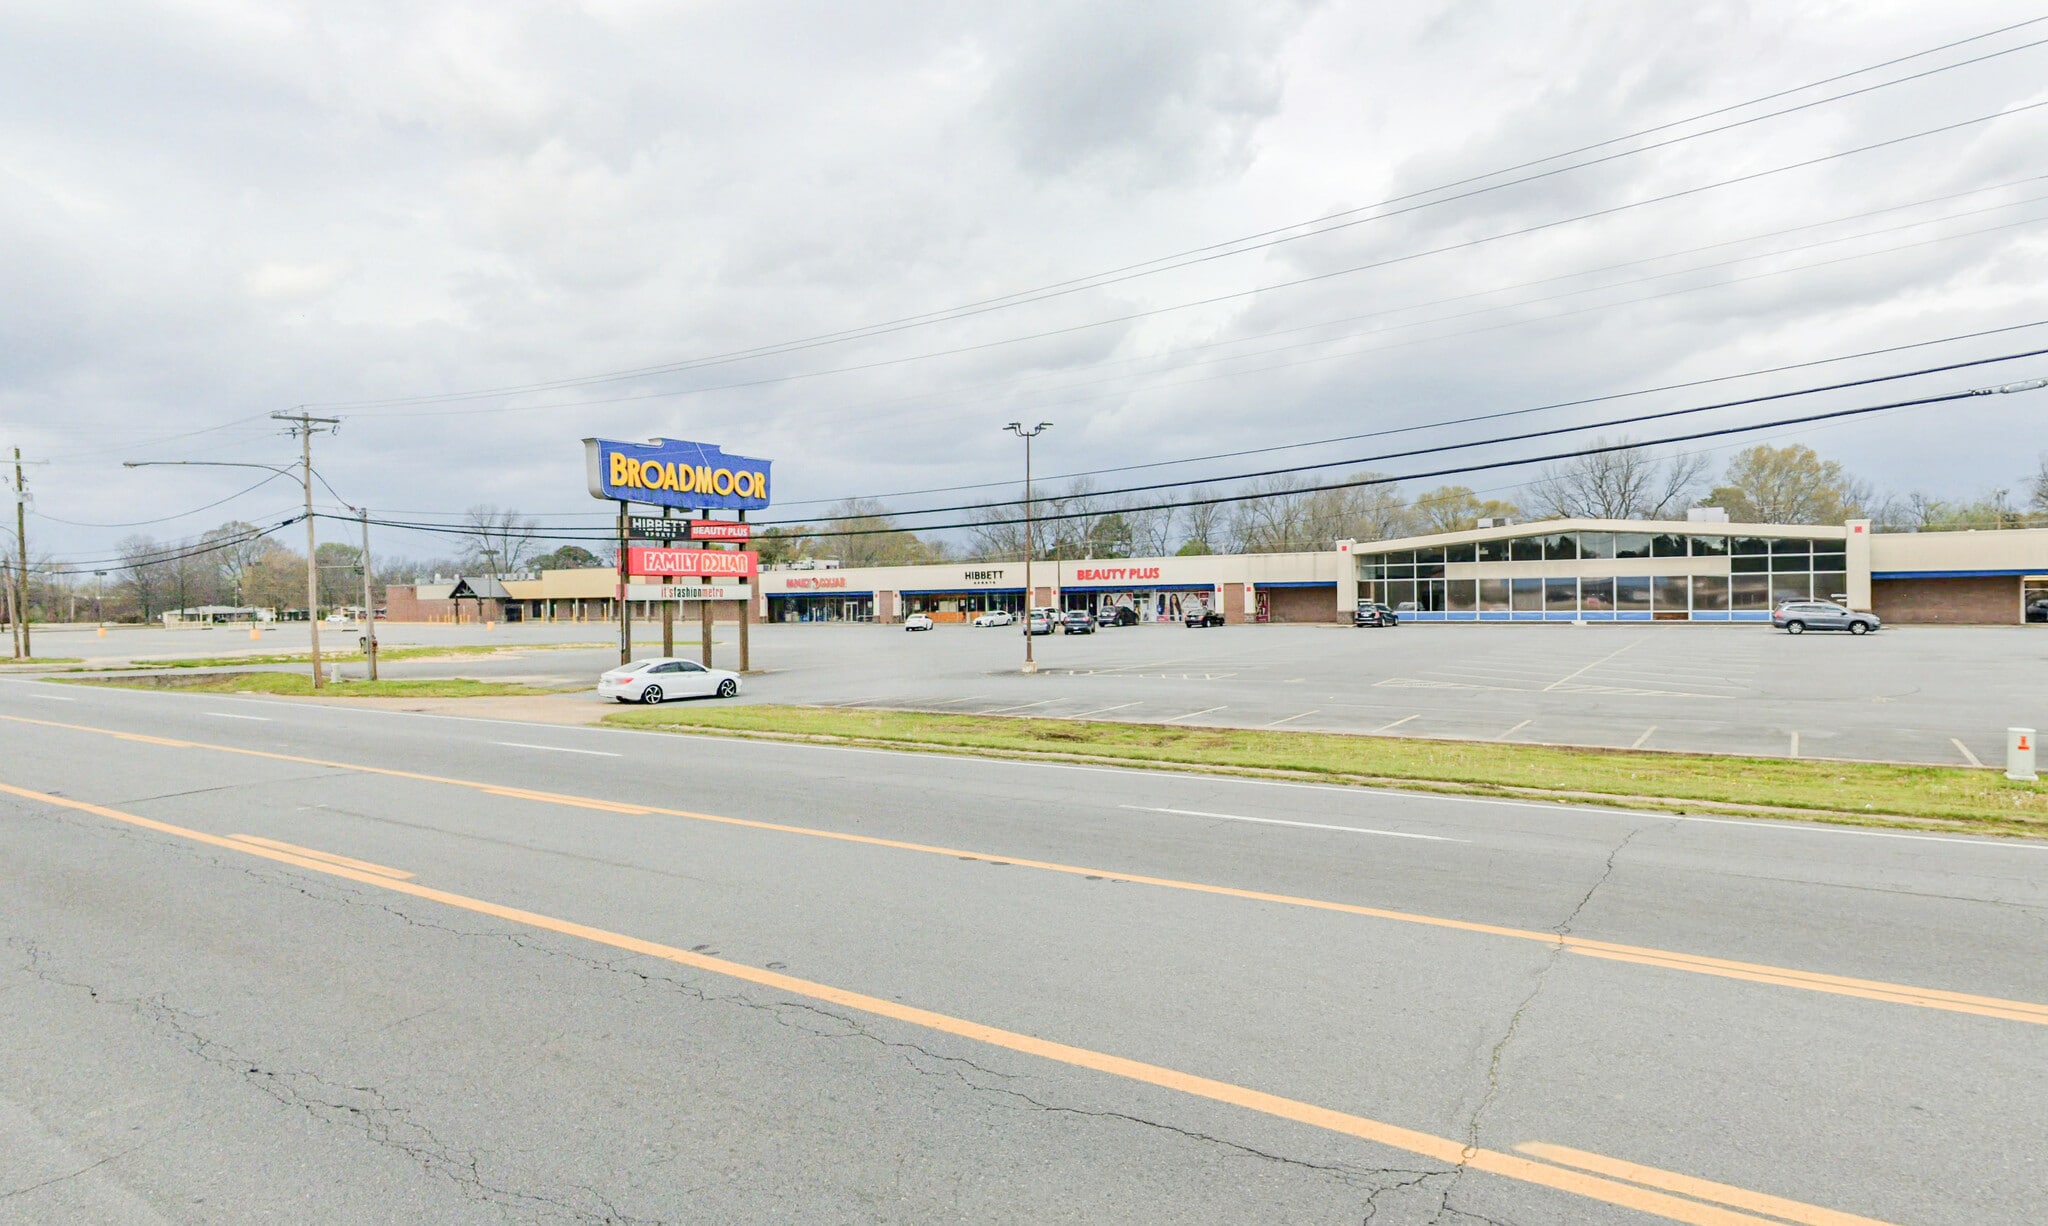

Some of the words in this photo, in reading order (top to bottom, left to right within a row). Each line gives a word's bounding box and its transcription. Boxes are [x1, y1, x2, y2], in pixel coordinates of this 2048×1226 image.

[609, 452, 766, 499] BROADMOOR
[632, 517, 687, 533] HIBBETT
[692, 526, 727, 536] BEAUTY
[727, 527, 748, 537] PLUS
[643, 551, 699, 572] FAMILY
[701, 552, 748, 573] DOLLAR
[964, 570, 1004, 580] HIBBETT
[1077, 568, 1126, 581] BEAUTY
[1129, 567, 1160, 580] PLUS
